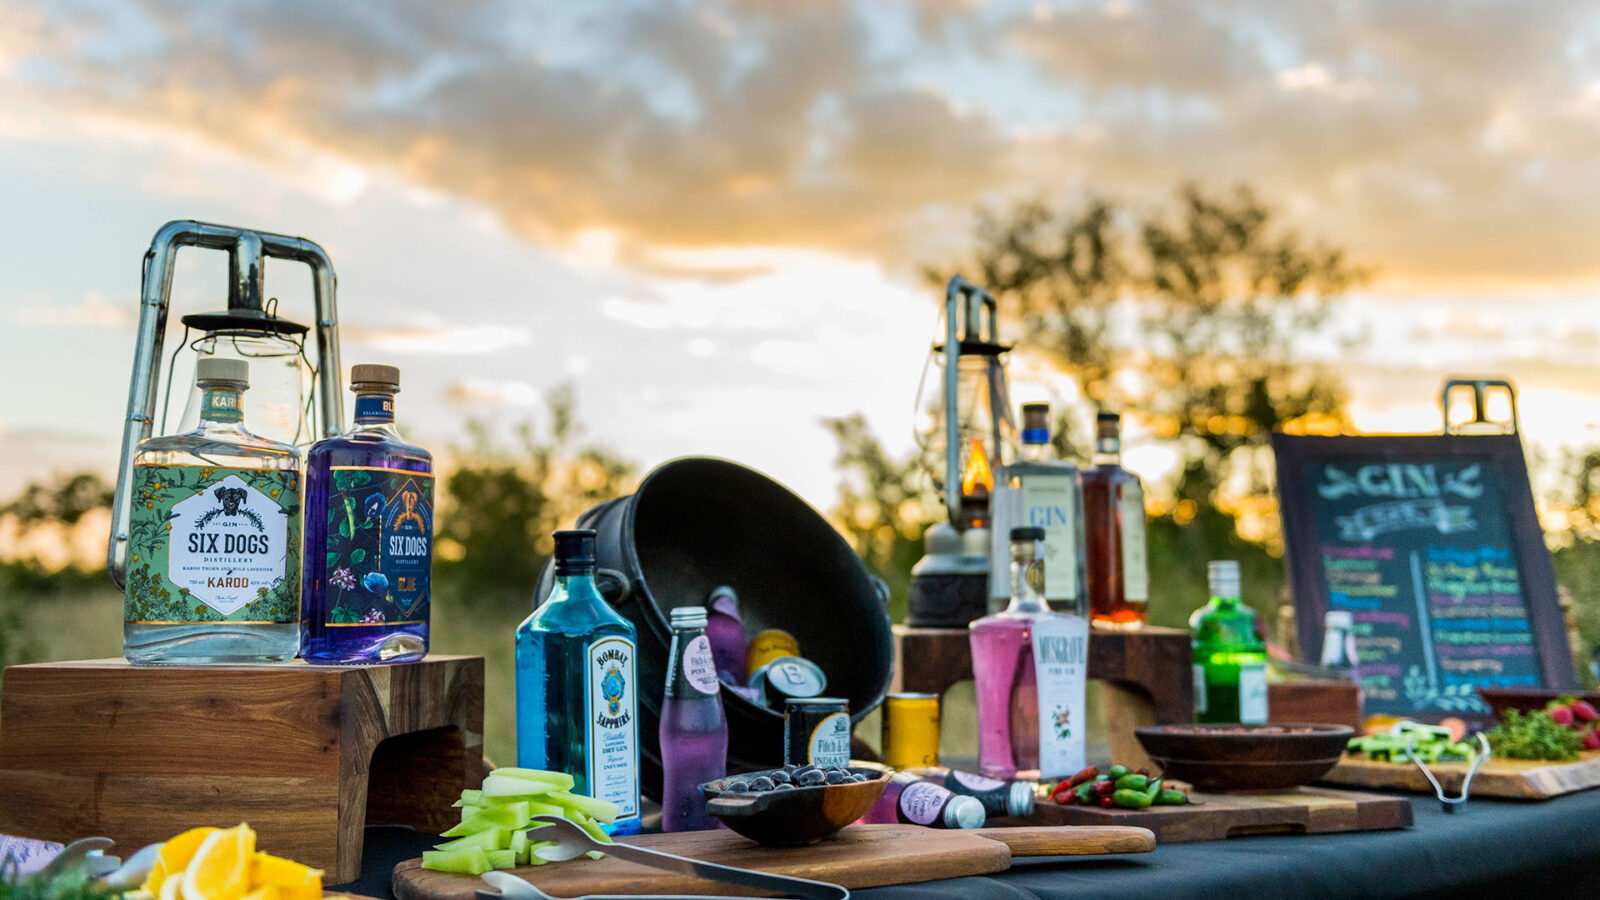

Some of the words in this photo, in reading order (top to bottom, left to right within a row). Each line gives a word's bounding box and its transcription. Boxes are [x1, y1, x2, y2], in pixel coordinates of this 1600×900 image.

[1356, 463, 1439, 497] GIN
[1029, 504, 1067, 528] GIN
[188, 532, 220, 554] SIX
[223, 533, 269, 555] DOGS
[389, 535, 405, 556] SIX
[405, 536, 428, 557] DOGS
[203, 556, 254, 564] DISTILLERY
[207, 576, 249, 589] KAROO
[596, 648, 629, 670] BOMBAY
[596, 708, 632, 729] SAPPHIRE
[818, 739, 836, 752] Fitch
